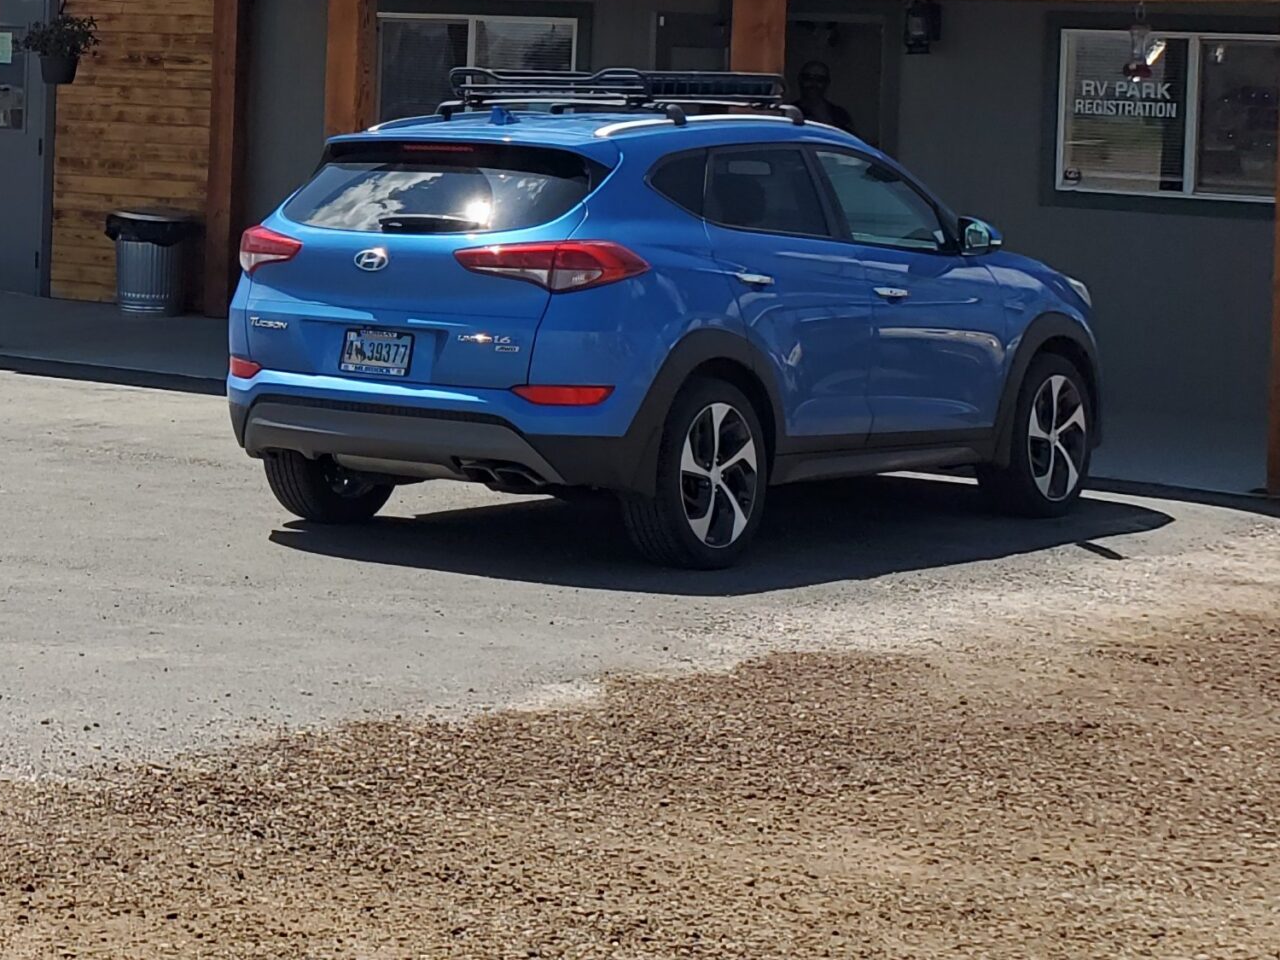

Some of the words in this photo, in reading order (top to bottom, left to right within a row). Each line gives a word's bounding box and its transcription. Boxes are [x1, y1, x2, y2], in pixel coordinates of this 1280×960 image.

[1081, 80, 1109, 96] RV
[1115, 81, 1172, 100] PARK
[1074, 99, 1178, 118] REGISTRATION
